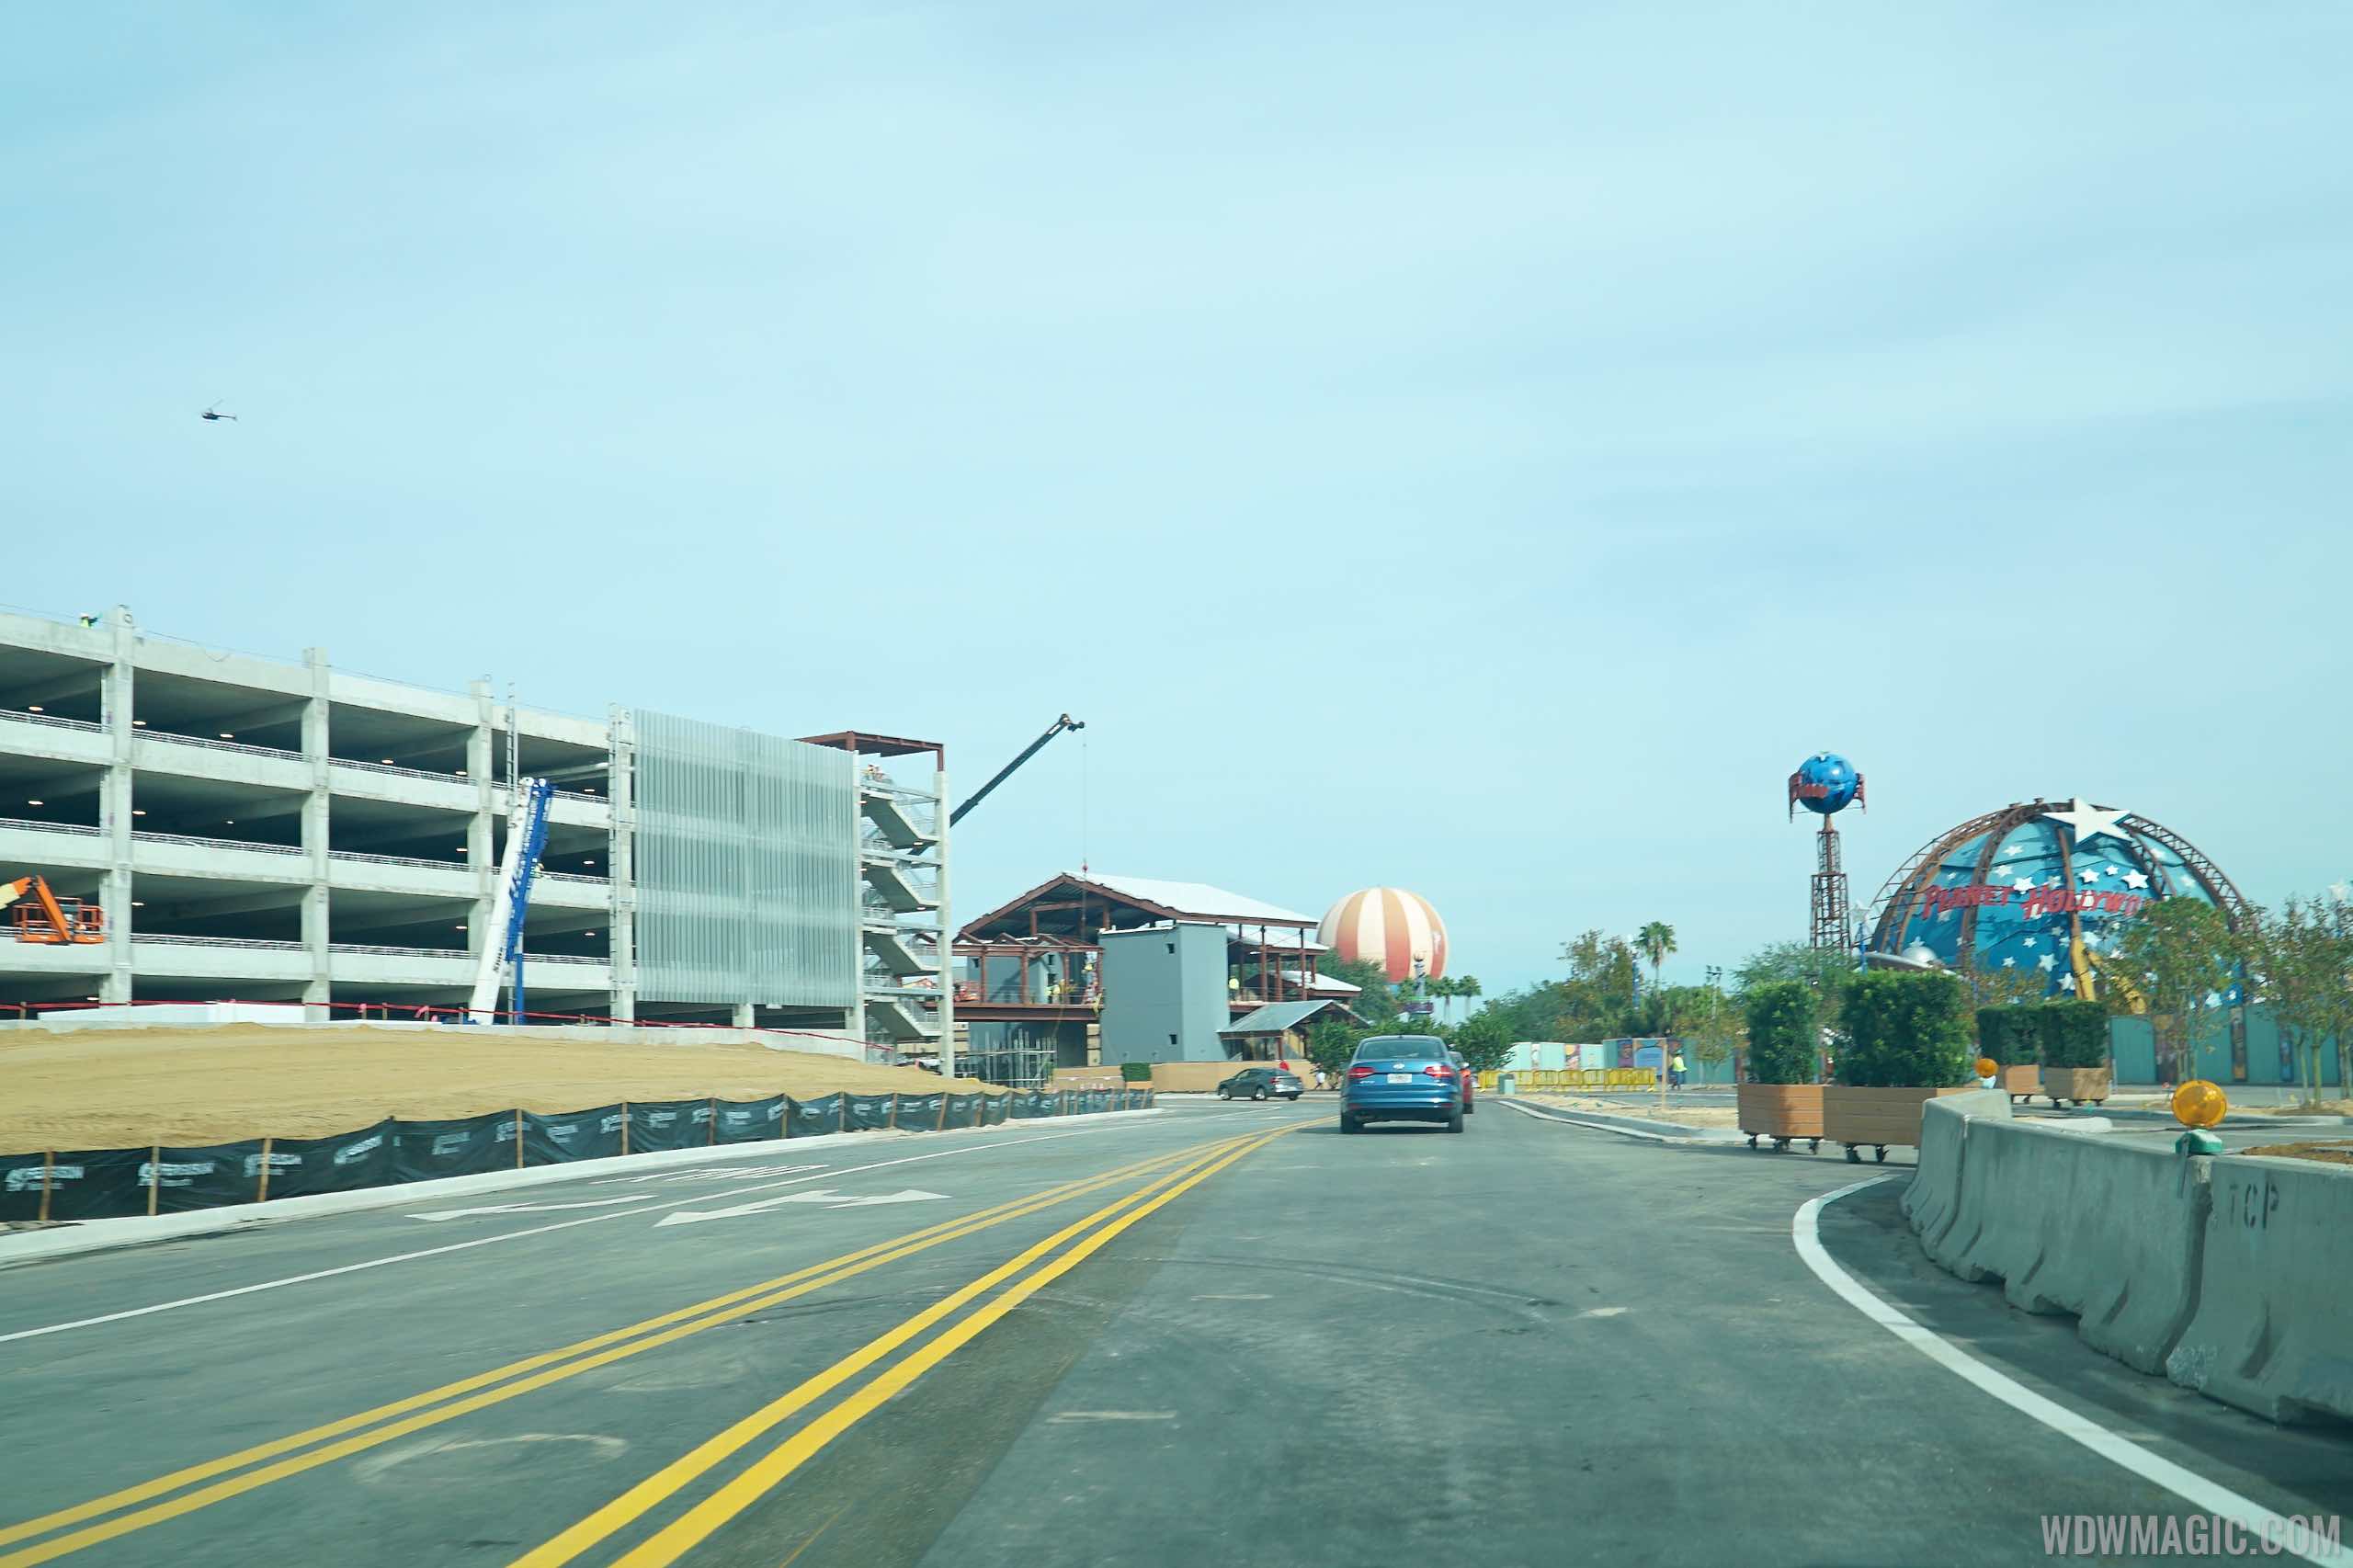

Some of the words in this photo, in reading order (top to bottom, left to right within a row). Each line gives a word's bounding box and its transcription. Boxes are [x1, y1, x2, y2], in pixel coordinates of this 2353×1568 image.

[1922, 884, 2015, 920] PLANET
[2020, 883, 2142, 920] HOLLYWO
[2229, 1182, 2279, 1229] TCP
